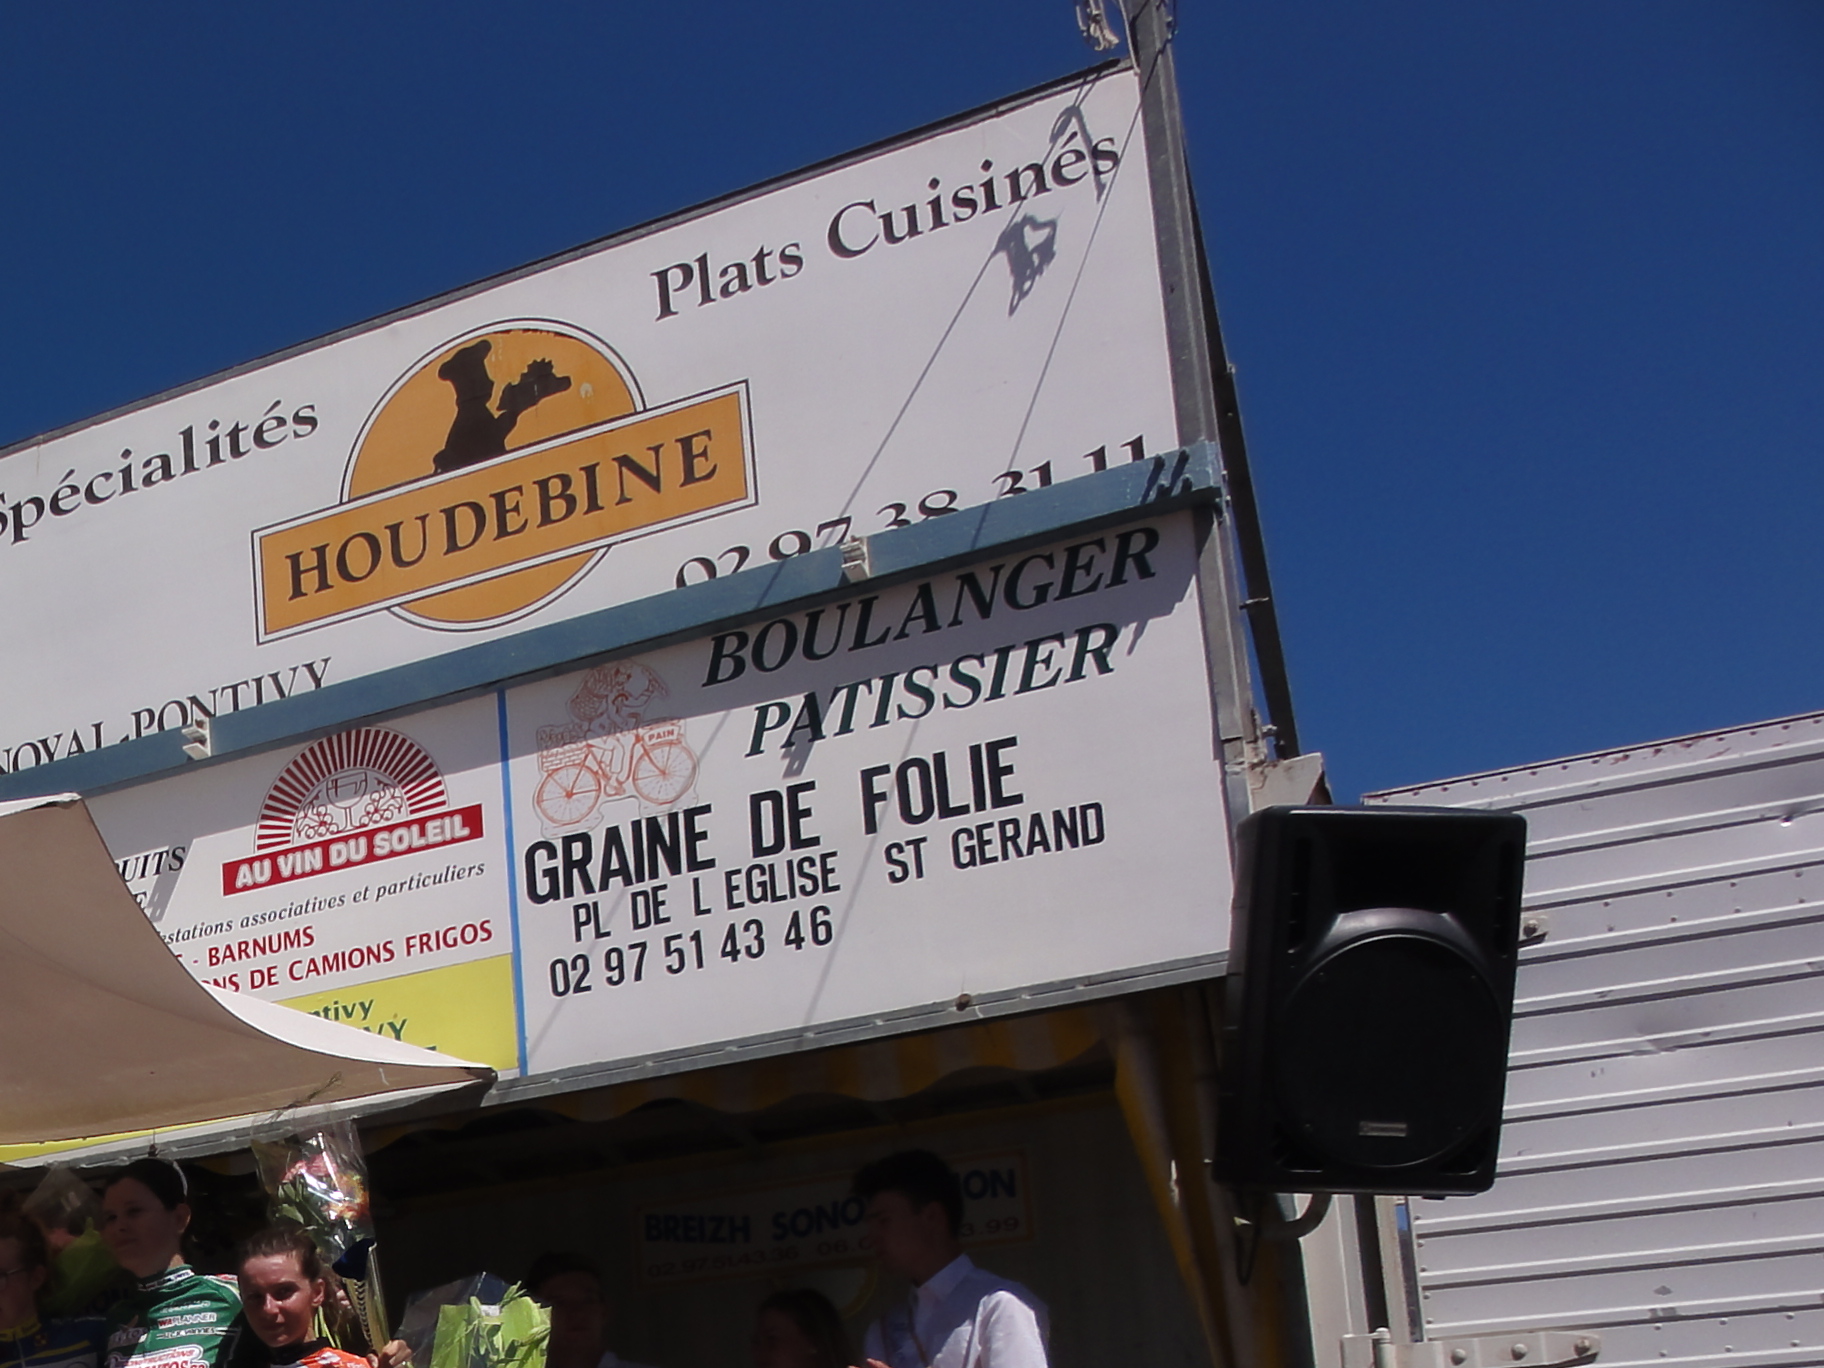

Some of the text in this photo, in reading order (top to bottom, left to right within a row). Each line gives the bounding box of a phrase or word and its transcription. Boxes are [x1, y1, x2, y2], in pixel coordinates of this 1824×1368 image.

[650, 130, 1120, 322] Plats Cuisinés
[284, 429, 719, 602] HOUDEBINE
[702, 527, 1160, 688] BOULANGER
[648, 729, 675, 742] PAIN
[745, 622, 1120, 758] PATISSIER
[235, 813, 470, 889] AU VIN DU SOLEIL
[525, 736, 1024, 904] GRAINE DE FOLIE
[240, 894, 345, 929] associatives
[353, 887, 370, 905] et
[375, 861, 485, 902] particuliers
[573, 801, 1106, 943] PL DE L EGLISE ST GERAND
[207, 925, 315, 968] BARNUMS
[249, 966, 279, 990] DE
[288, 941, 395, 981] CAMIONS
[404, 920, 493, 958] FRIGOS
[549, 904, 833, 998] 02 97 51 43 46
[645, 1213, 750, 1243] BREIZH
